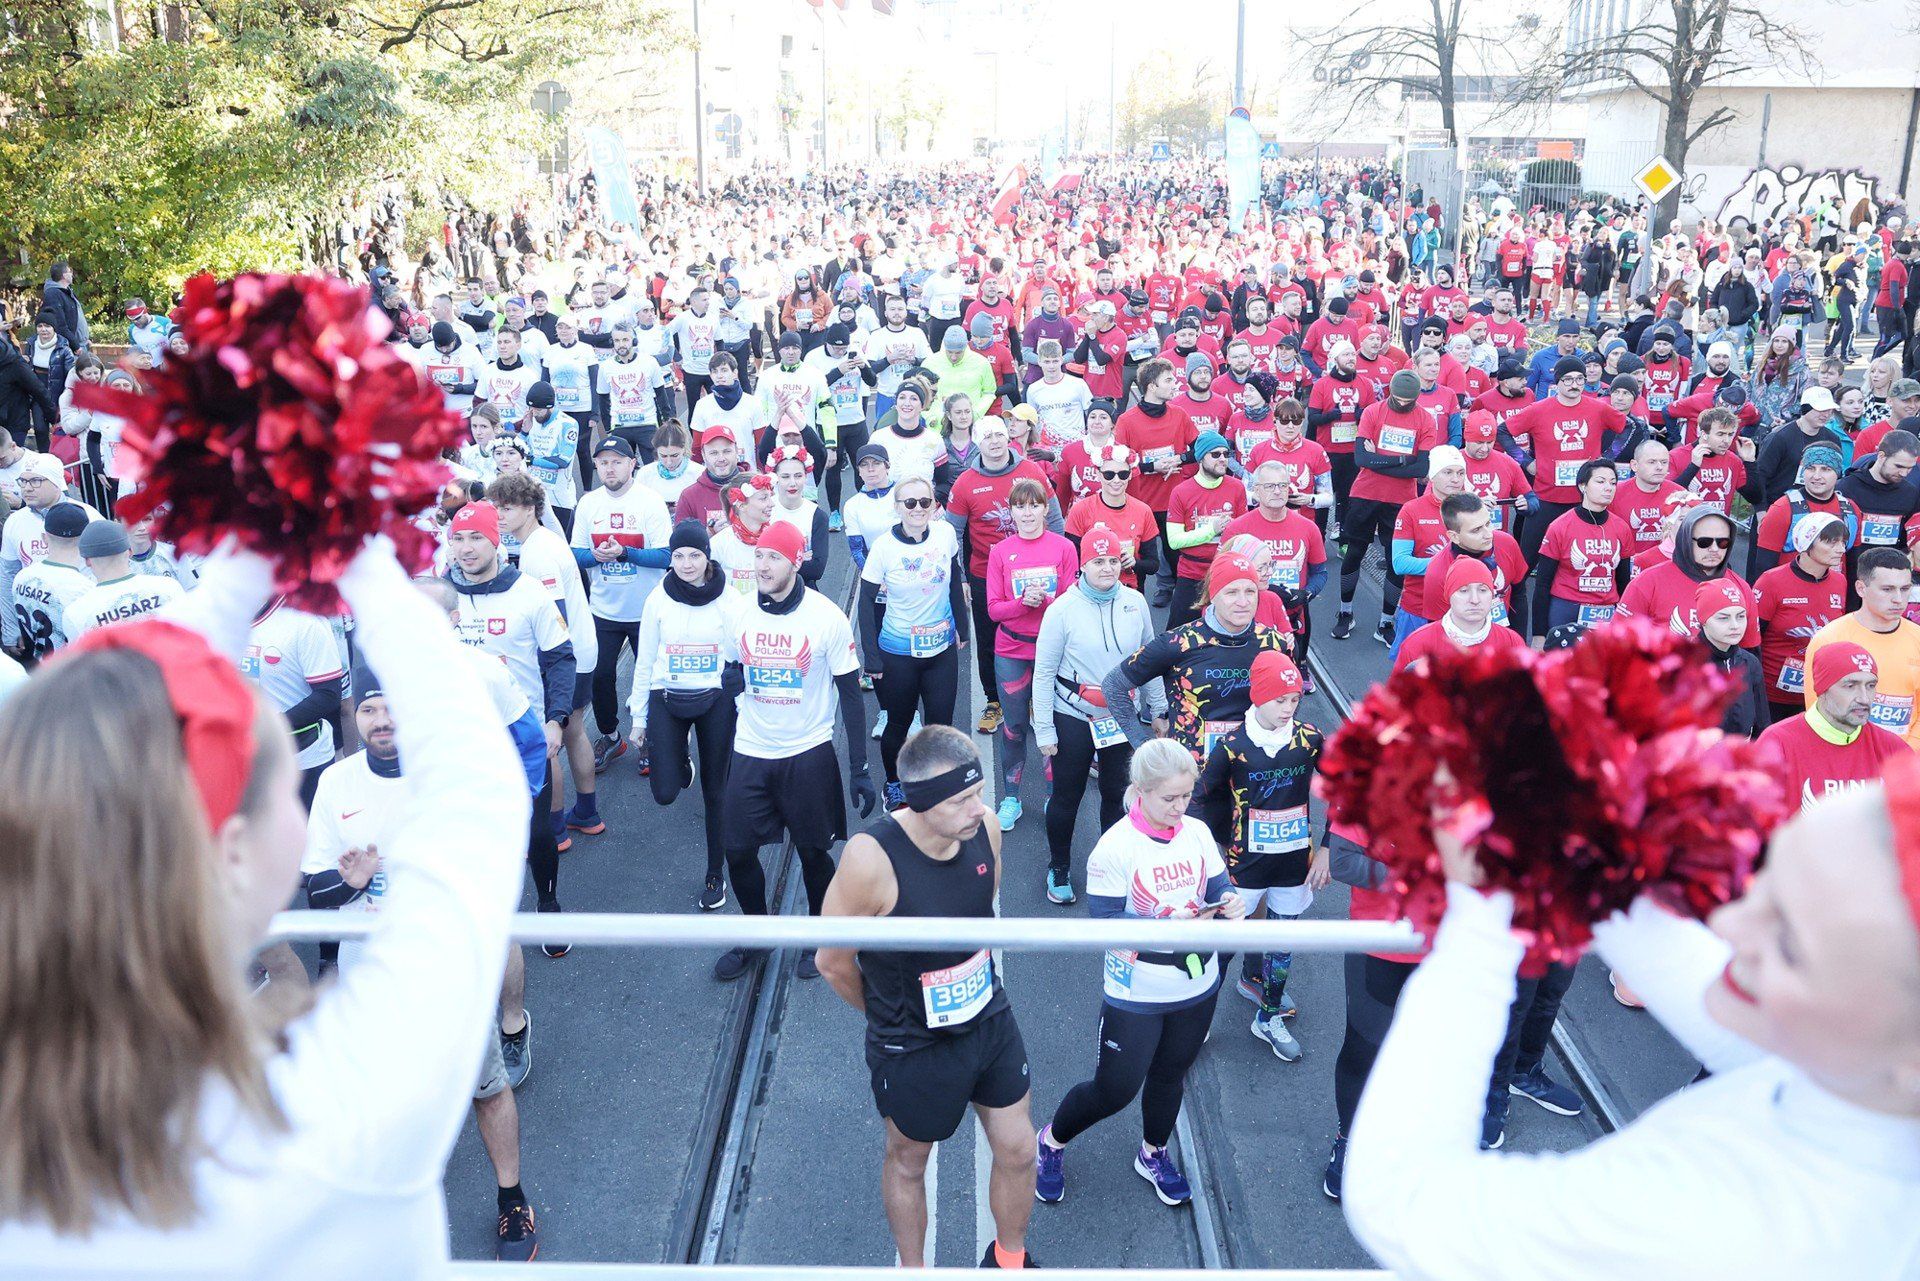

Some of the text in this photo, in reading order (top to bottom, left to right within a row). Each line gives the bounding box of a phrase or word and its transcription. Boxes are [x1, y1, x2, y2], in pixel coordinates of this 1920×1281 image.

[783, 384, 802, 392] RUN
[1191, 416, 1211, 424] RUN
[1384, 433, 1410, 446] 5816
[1701, 469, 1723, 477] RUN
[1872, 525, 1894, 535] 273
[1266, 540, 1293, 549] RUN
[1585, 539, 1612, 548] RUN
[602, 562, 631, 574] 4694
[1271, 570, 1295, 582] 442
[95, 595, 161, 627] HUSARZ
[755, 633, 792, 648] RUN
[919, 633, 945, 647] 1162
[755, 646, 792, 657] POLAND
[672, 656, 711, 669] 3639
[753, 668, 794, 685] 1254
[1871, 705, 1909, 721] 4847
[1258, 821, 1301, 839] 5164
[1152, 860, 1194, 884] RUN
[1156, 877, 1196, 893] POLAND
[935, 970, 987, 1007] 3985
